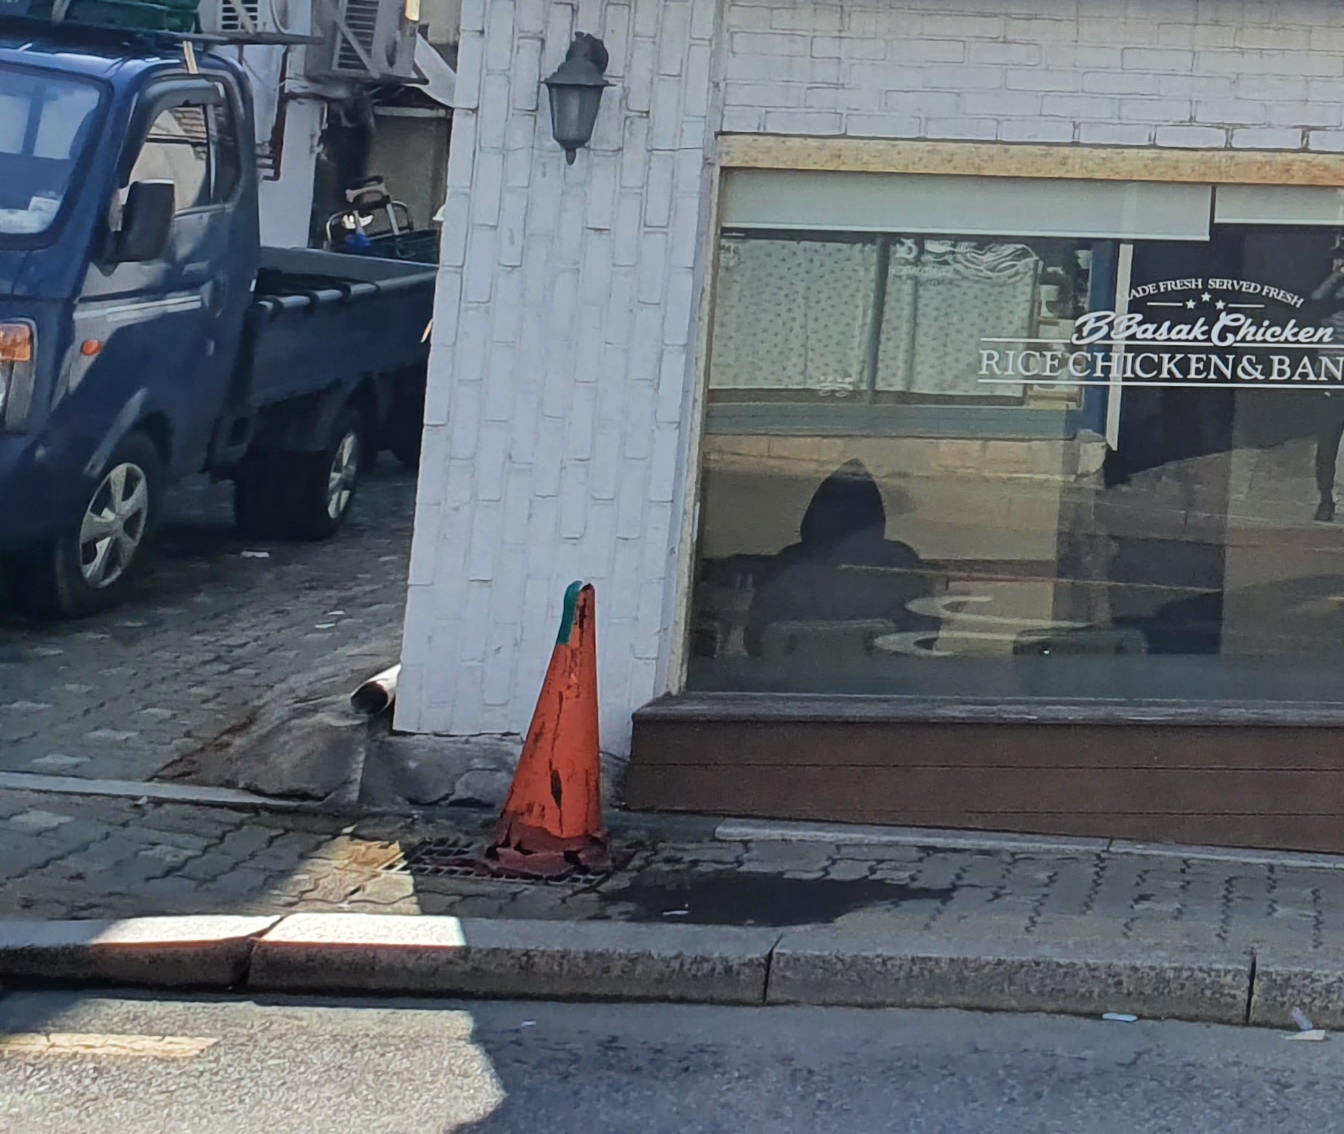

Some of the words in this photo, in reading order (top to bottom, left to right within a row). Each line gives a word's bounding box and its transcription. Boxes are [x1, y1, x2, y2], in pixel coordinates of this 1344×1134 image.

[1120, 283, 1158, 301] ADE
[1159, 278, 1202, 293] FRESH
[1208, 278, 1261, 294] SERVED
[1262, 285, 1305, 308] FRESH
[1211, 312, 1335, 348] Chicken
